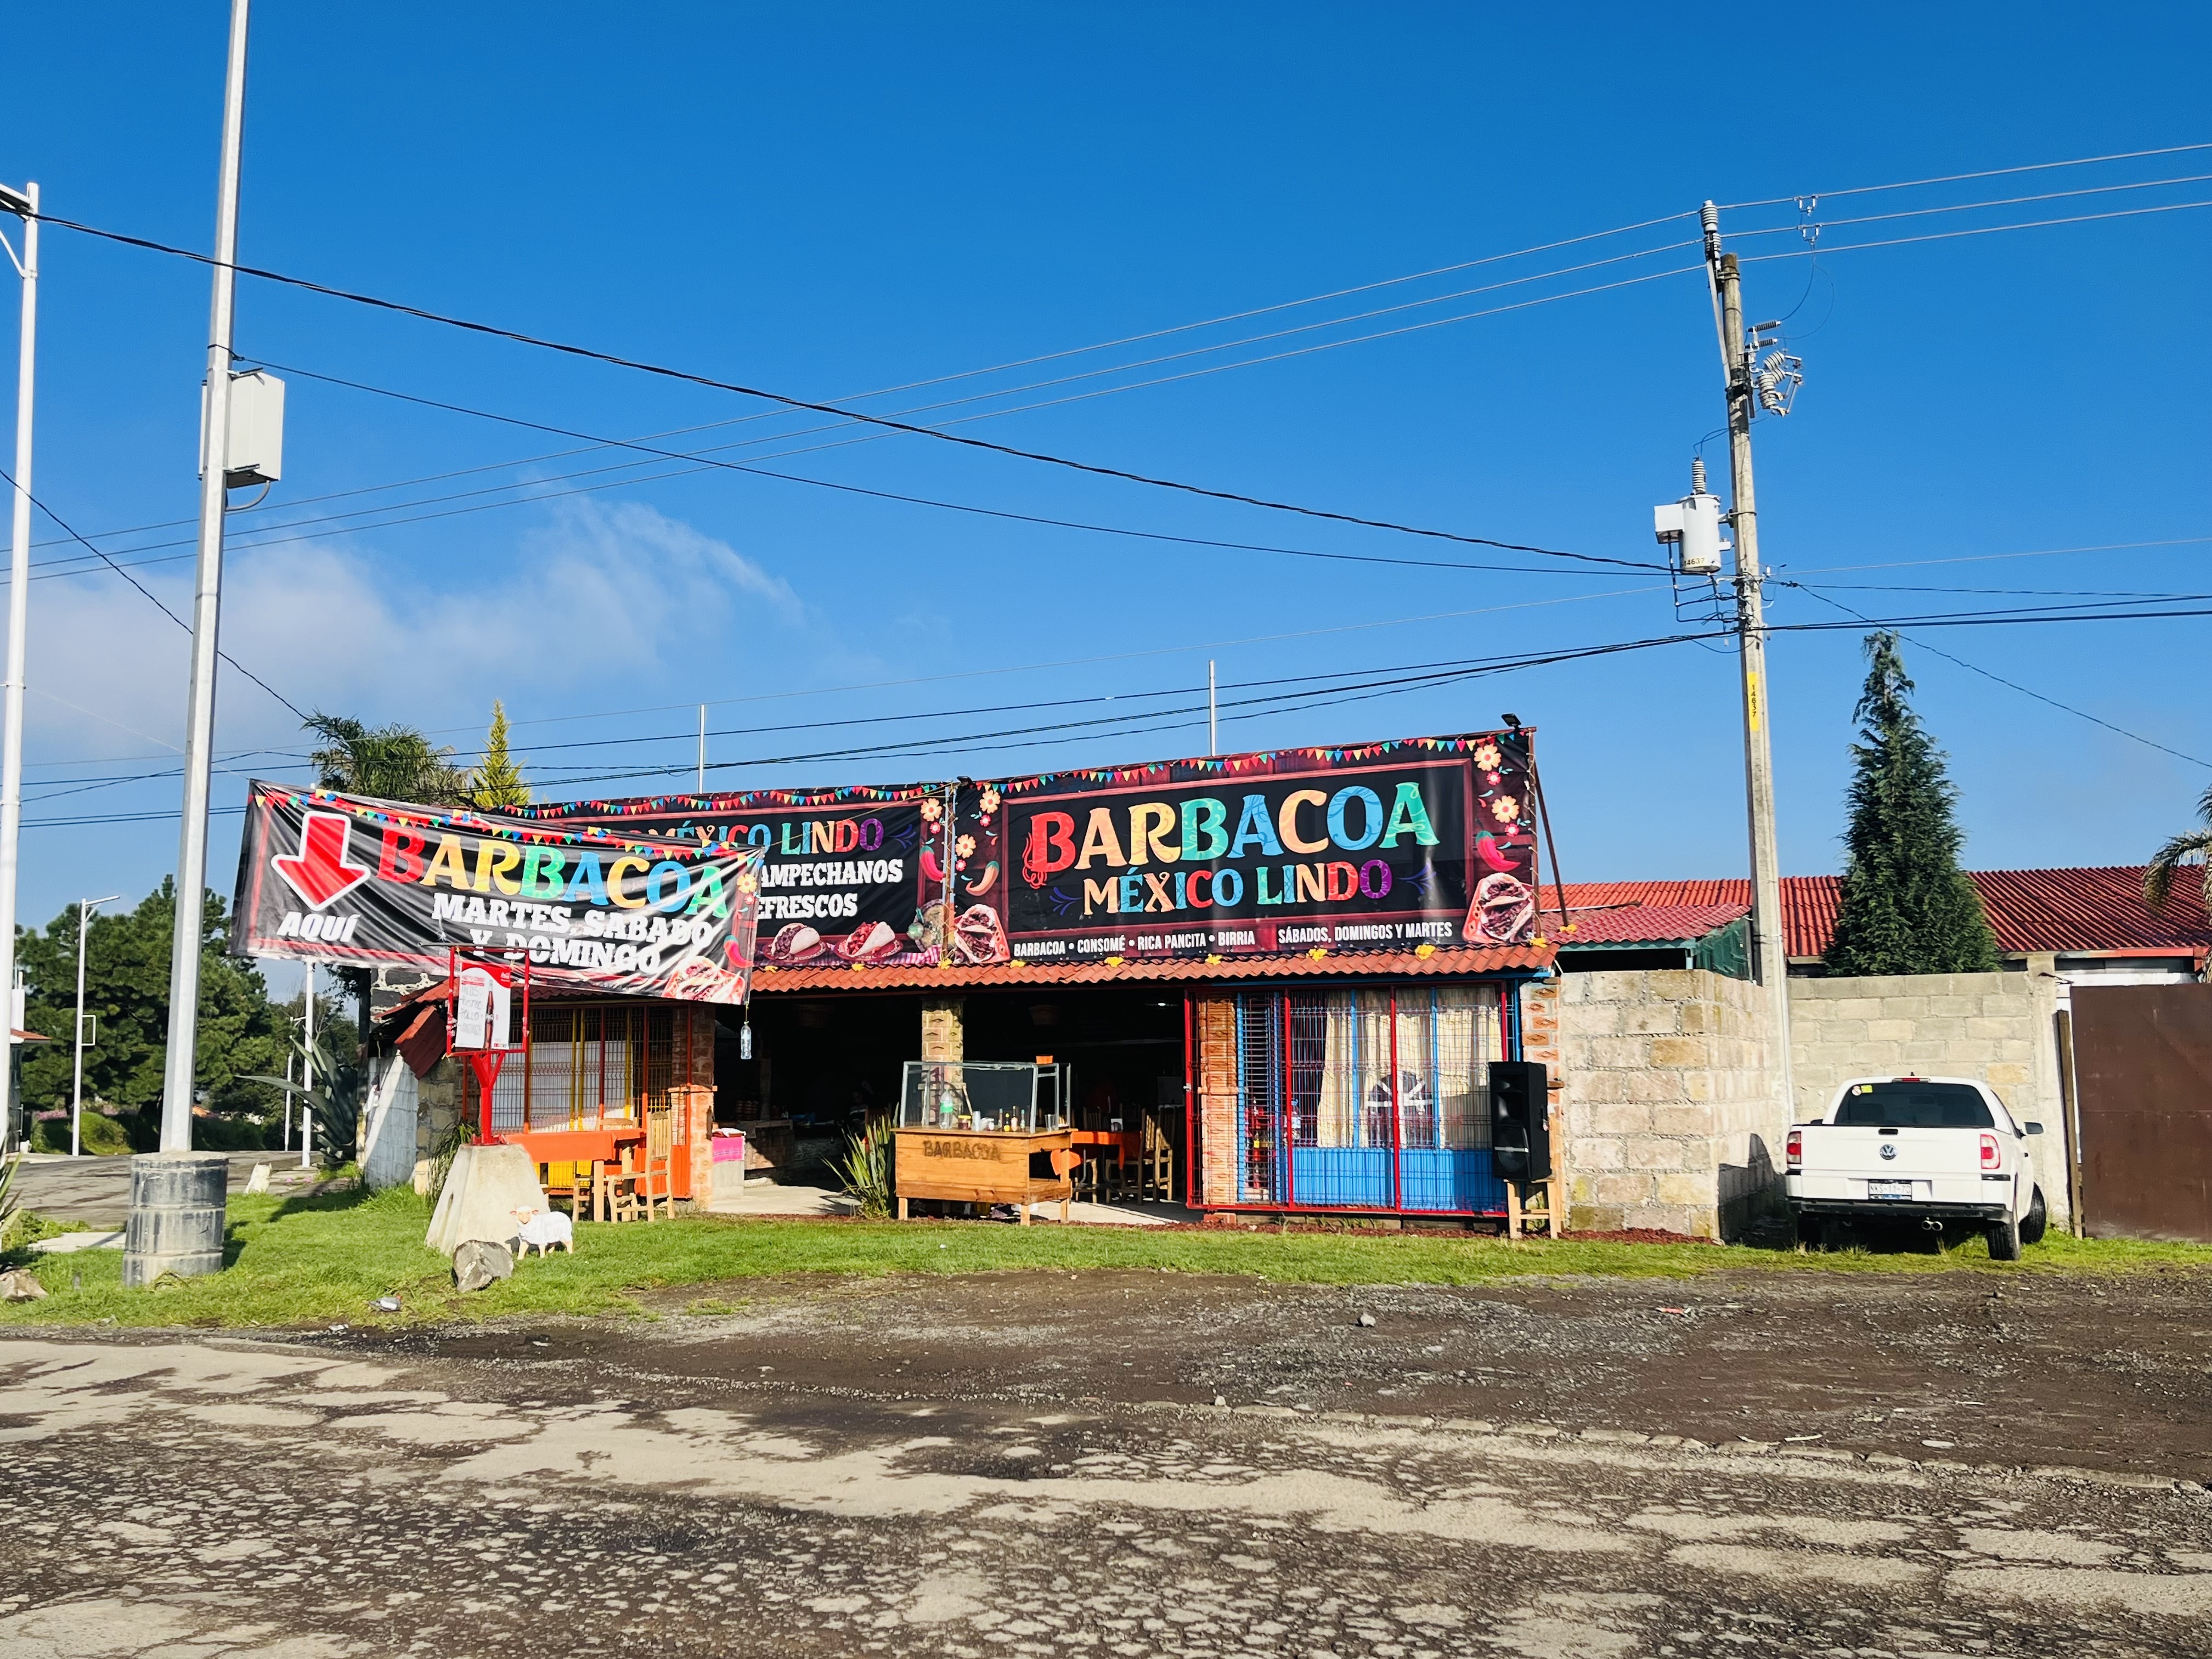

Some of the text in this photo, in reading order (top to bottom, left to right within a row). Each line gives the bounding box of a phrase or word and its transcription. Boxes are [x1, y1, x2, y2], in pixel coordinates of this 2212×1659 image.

[781, 818, 884, 855] LINDO
[1029, 782, 1440, 873] BARBACOA
[376, 827, 729, 918] BARBACOA
[761, 859, 903, 888] AMPECHANOS
[1084, 860, 1392, 916] MÉXICO LINDO
[757, 893, 857, 920] EFRESCOS
[276, 911, 360, 943] AQUÍ
[584, 909, 713, 948] SABADO
[1013, 930, 1255, 957] BARBACOA CONSOMÉ RICA PANCITA BIRRIA
[1278, 922, 1453, 944] SÁBADOS, DOMINGOS Y MARTES
[470, 928, 661, 974] Y DOMINGO
[922, 1141, 1002, 1160] BARBACOA
